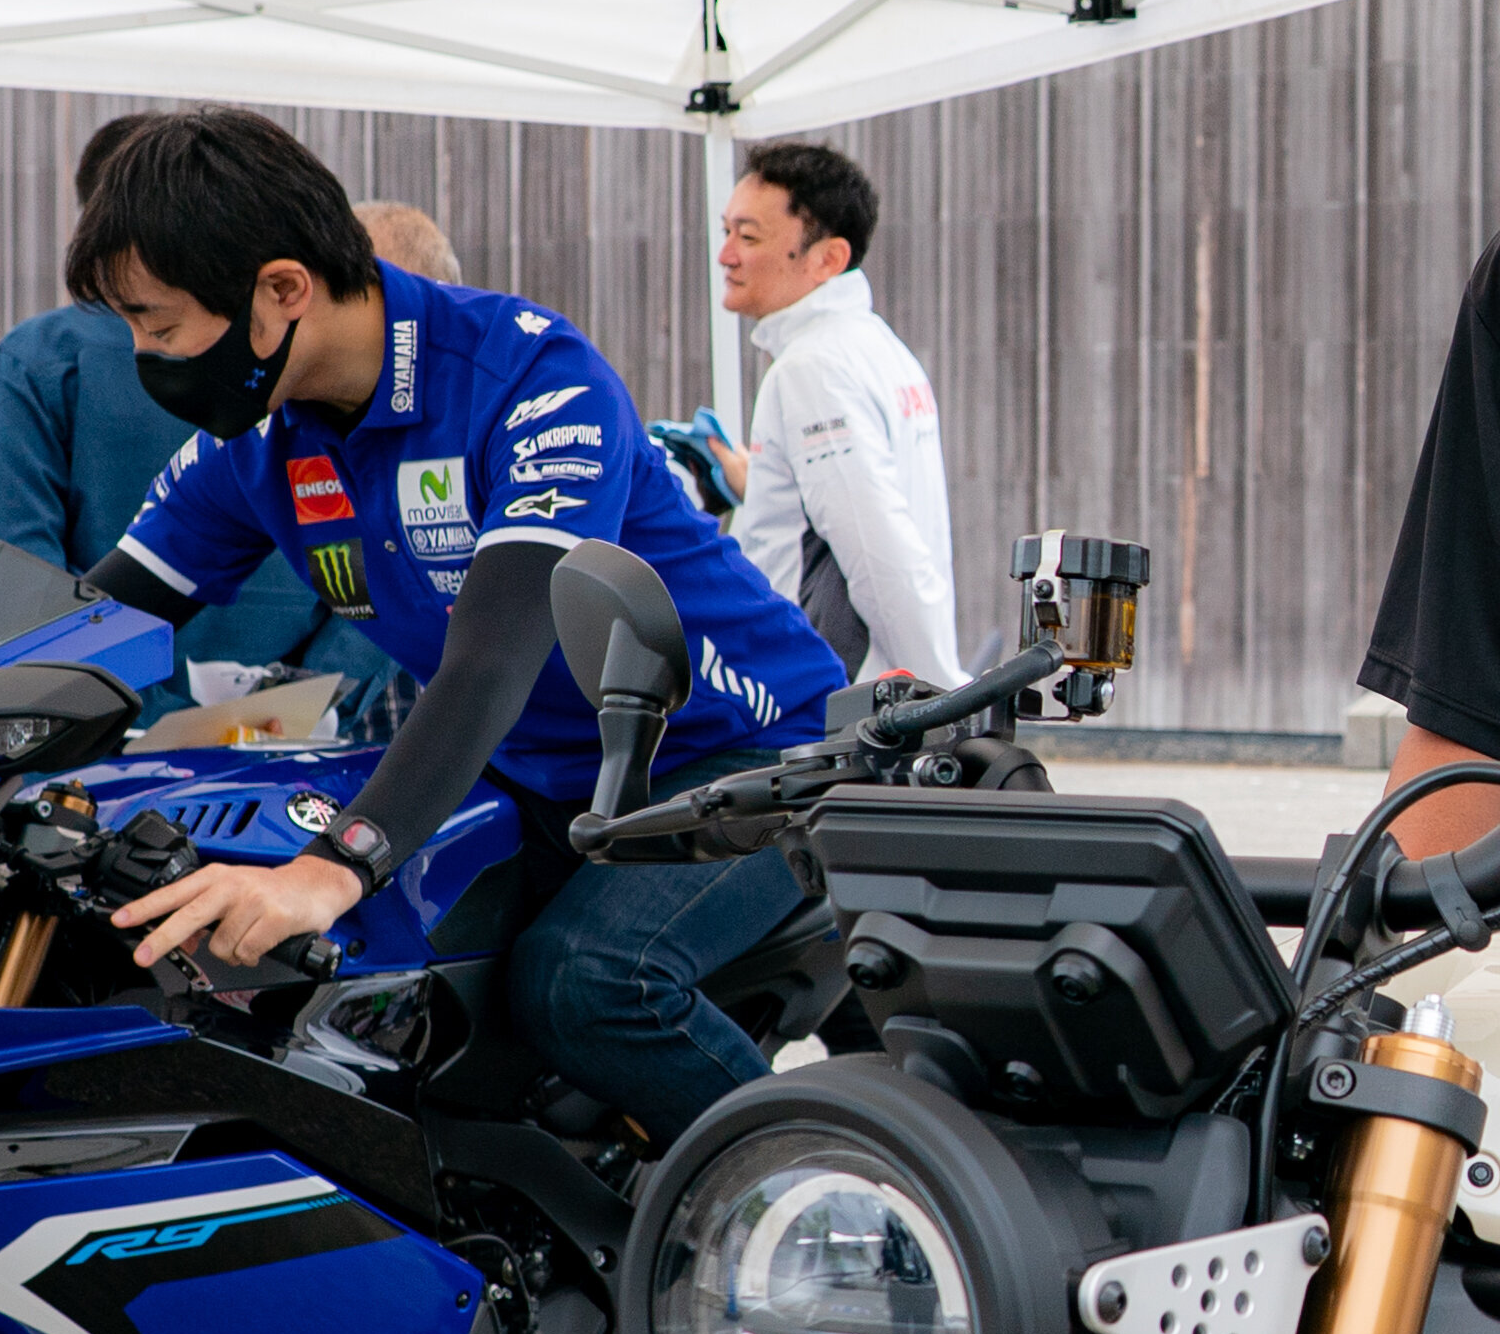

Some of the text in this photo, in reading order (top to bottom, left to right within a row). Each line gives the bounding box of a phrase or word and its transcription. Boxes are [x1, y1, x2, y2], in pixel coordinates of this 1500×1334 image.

[393, 319, 413, 392] YAMAHA
[295, 478, 344, 499] ENEOS
[541, 463, 600, 481] MICHELIN
[65, 1217, 222, 1266] R9
